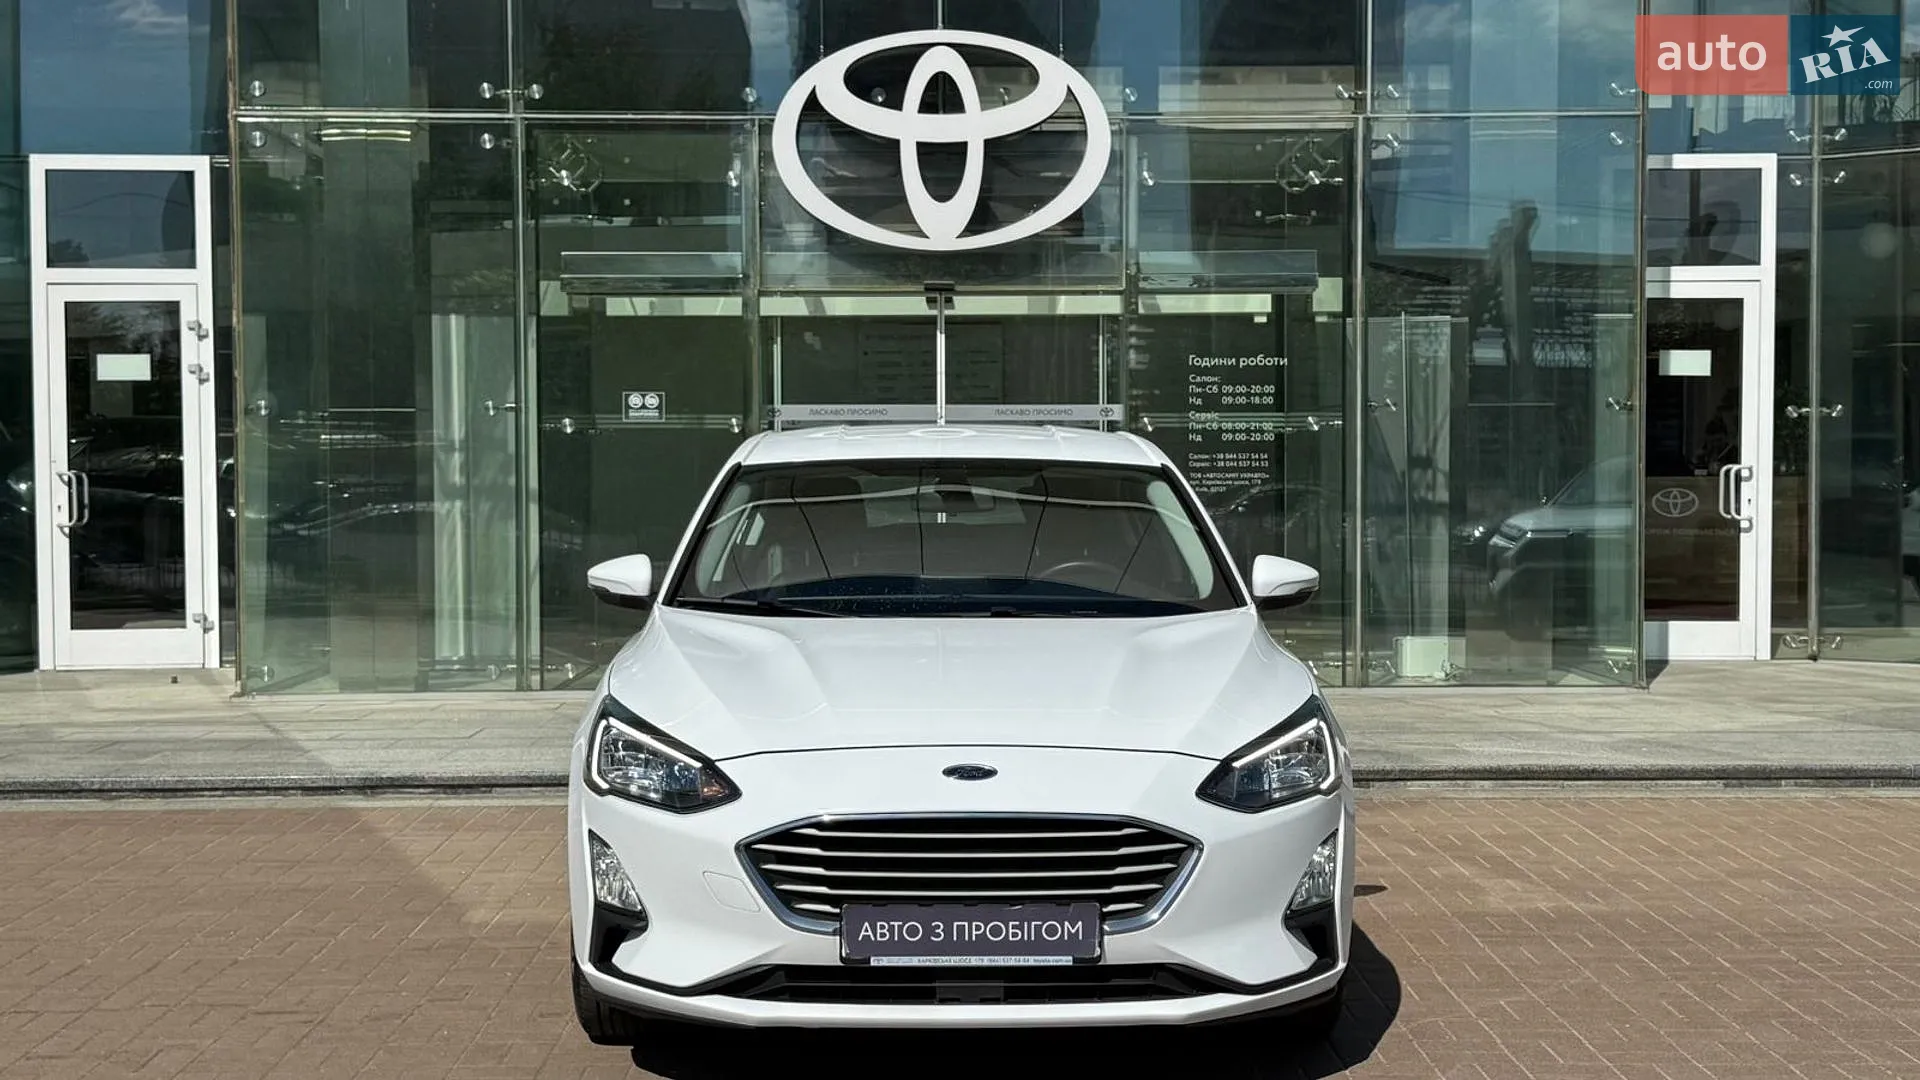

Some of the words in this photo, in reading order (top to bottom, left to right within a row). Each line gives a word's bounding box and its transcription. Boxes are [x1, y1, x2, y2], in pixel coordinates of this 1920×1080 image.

[1188, 354, 1236, 367] Години
[1239, 354, 1288, 368] роботи
[1188, 374, 1221, 383] Салон:
[1188, 384, 1219, 393] Пн-Сб
[1221, 385, 1275, 393] 09:00-20:00
[1188, 396, 1202, 405] Нд
[1221, 396, 1274, 404] 09:00-18:00
[847, 408, 888, 416] ПРОСИМО
[1033, 408, 1074, 416] ПРОСИМО
[1188, 422, 1219, 431] Пн-Сб
[1221, 422, 1274, 431] 08:00-21:00
[1188, 433, 1202, 442] Нд
[1221, 433, 1275, 441] 09:00-20:00
[858, 921, 923, 941] АВТО
[930, 921, 945, 941] З
[953, 921, 1083, 941] ПРОБІГОМ
